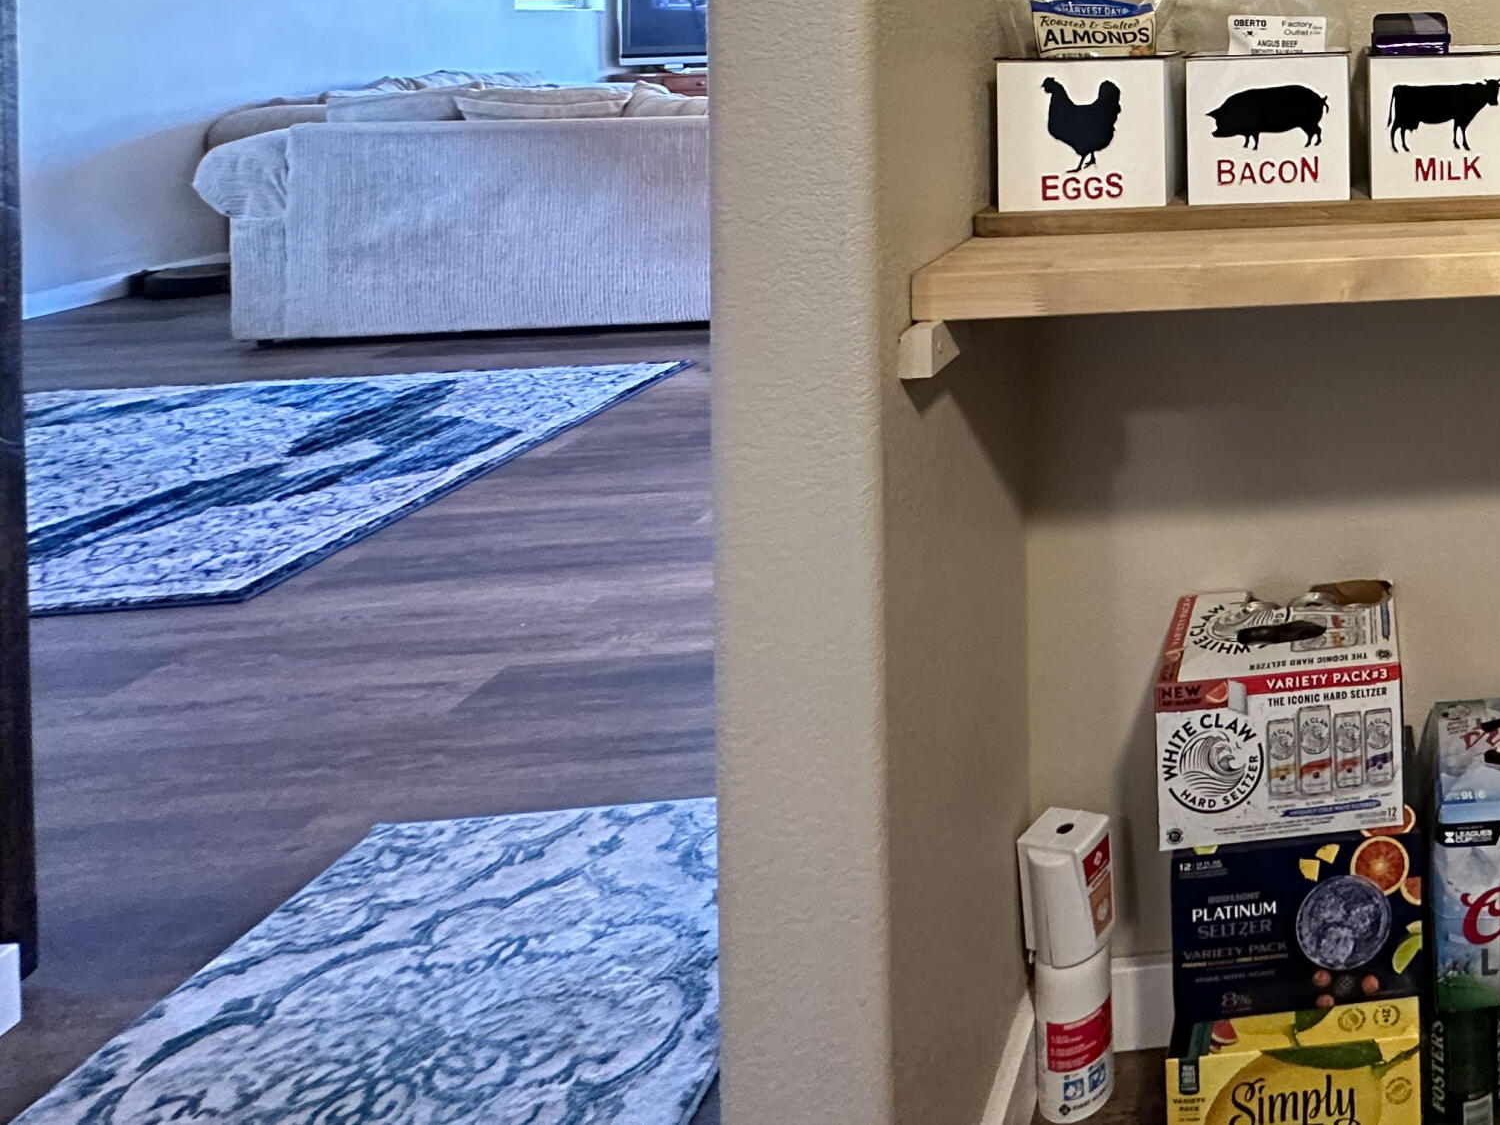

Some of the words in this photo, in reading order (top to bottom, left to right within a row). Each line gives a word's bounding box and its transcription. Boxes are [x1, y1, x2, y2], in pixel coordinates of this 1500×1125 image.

[1039, 16, 1086, 27] Roasted
[1102, 19, 1139, 30] Salted
[1233, 19, 1267, 27] OBERTO
[1043, 27, 1150, 47] ALMONDS
[1281, 40, 1298, 48] BEEF
[1216, 155, 1320, 186] BACON
[1415, 156, 1482, 181] MILK
[1040, 172, 1123, 202] EGGS
[1249, 660, 1286, 670] SELTZER
[1289, 658, 1314, 668] HARD
[1316, 654, 1348, 665] ICONIC
[1350, 651, 1368, 661] THE
[1266, 674, 1328, 690] VARIETY
[1161, 686, 1200, 699] NEW
[1267, 697, 1285, 707] THE
[1287, 692, 1321, 705] ICONIC
[1323, 690, 1348, 701] HARD
[1350, 686, 1388, 698] SELTZER
[1162, 720, 1197, 782] WHITE
[1199, 713, 1257, 743] CLAW
[1180, 789, 1217, 808] HARD
[1222, 754, 1259, 806] SELTZER
[1386, 807, 1398, 818] 12
[1179, 863, 1191, 872] 12
[1191, 901, 1277, 923] PLATINUM
[1198, 919, 1272, 940] SELTZER
[1183, 946, 1243, 961] VARIETY
[1249, 941, 1288, 955] PACK
[1431, 1020, 1446, 1115] FOSTER'S
[1229, 1074, 1357, 1125] Simply
